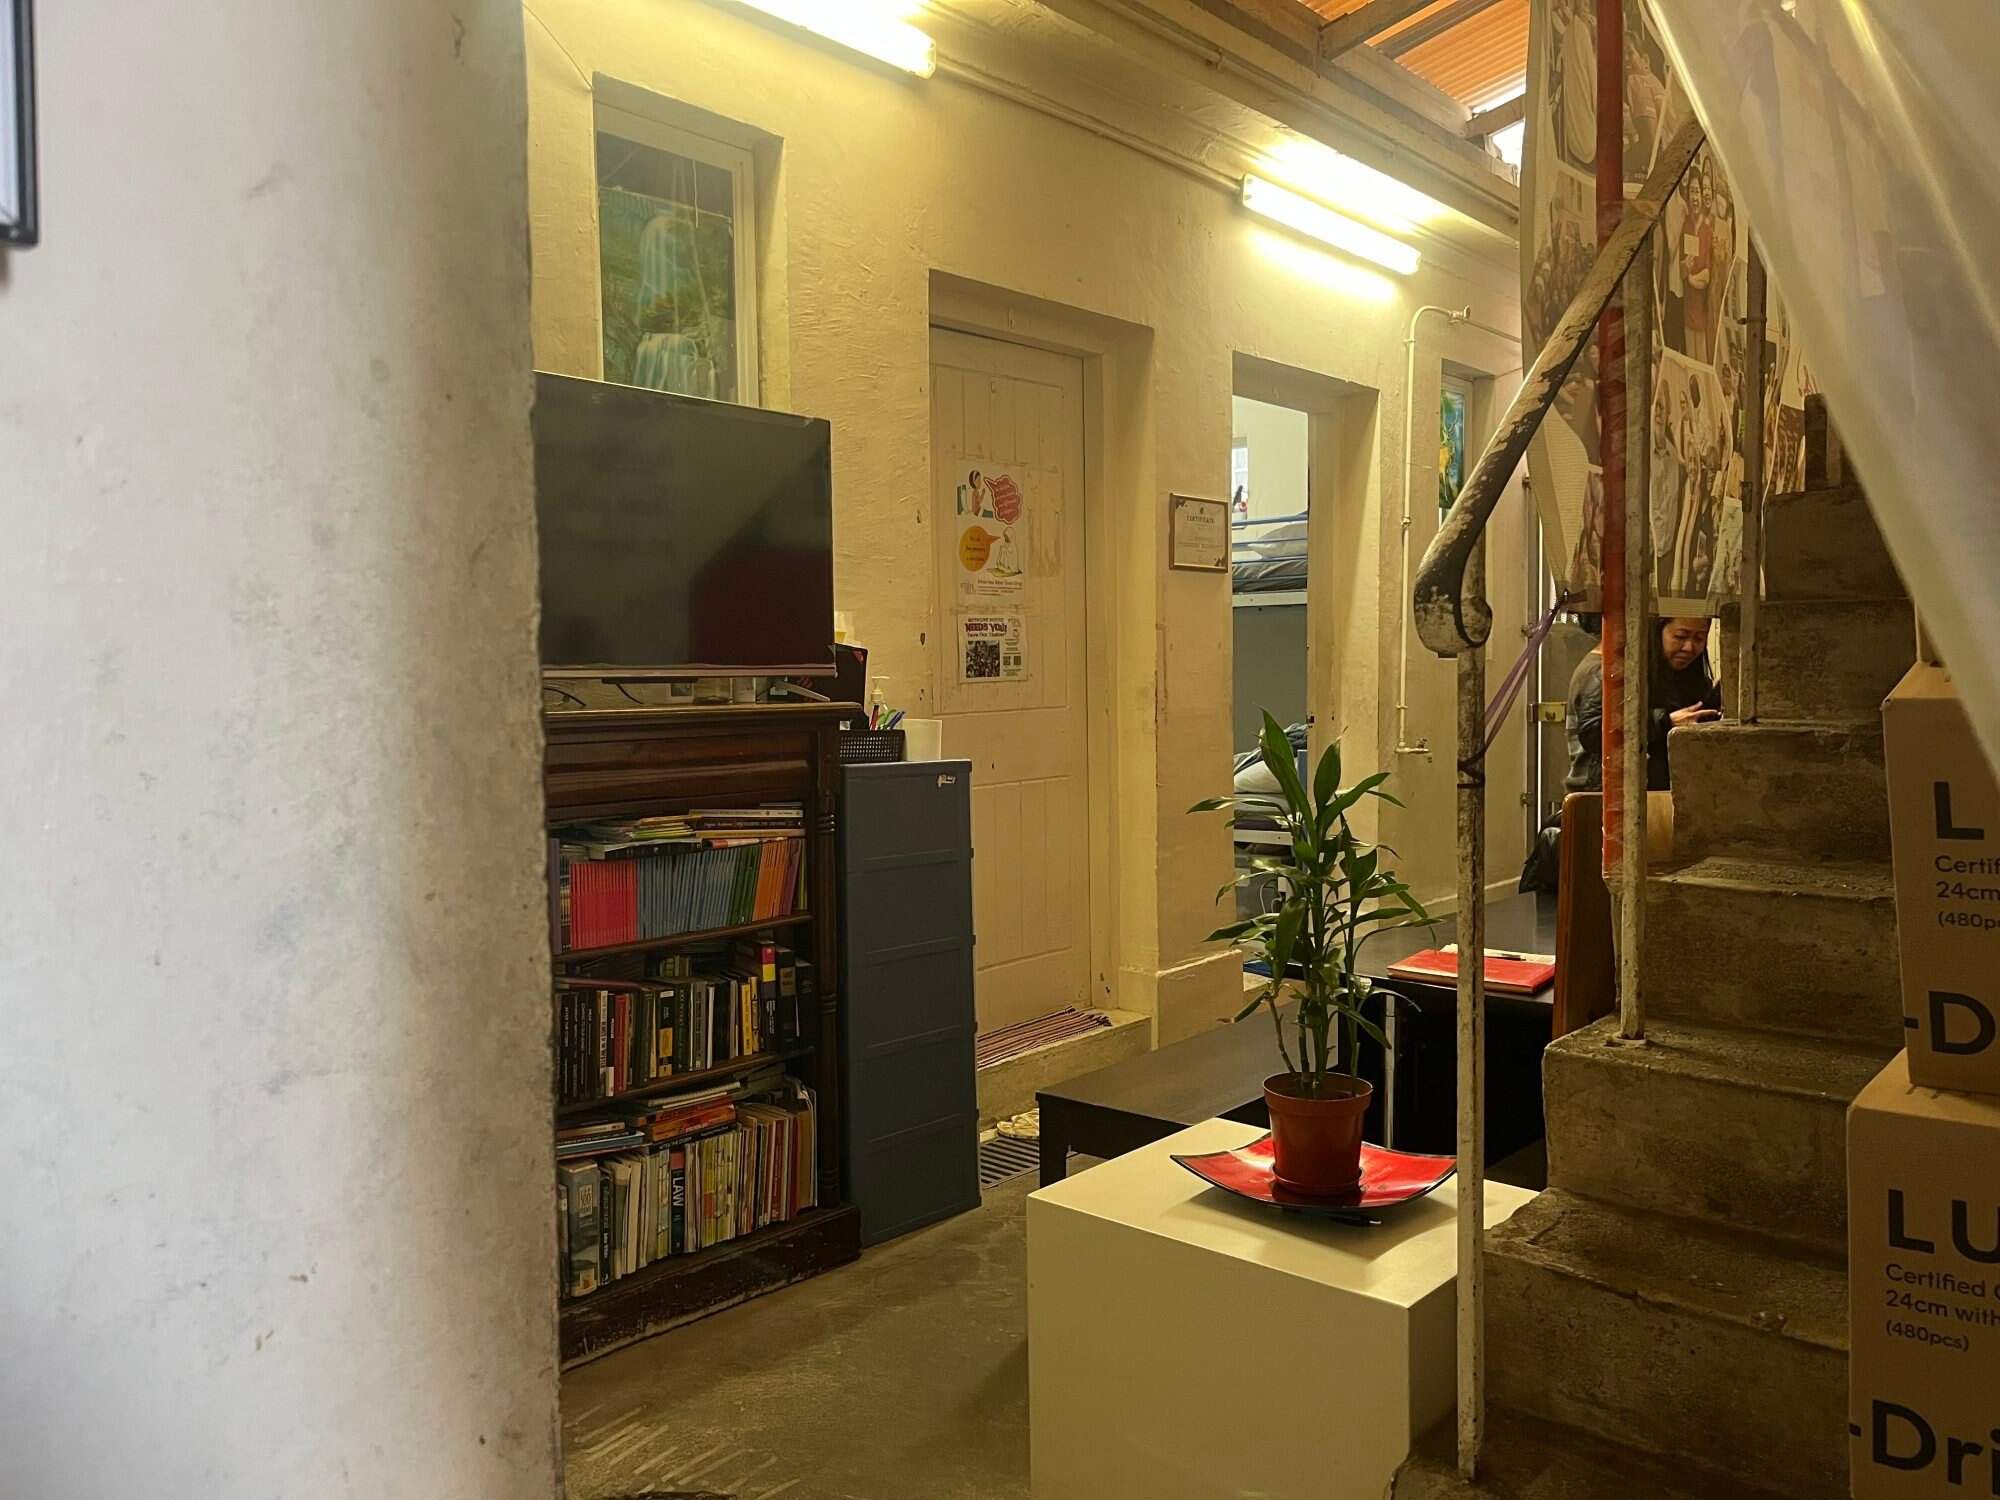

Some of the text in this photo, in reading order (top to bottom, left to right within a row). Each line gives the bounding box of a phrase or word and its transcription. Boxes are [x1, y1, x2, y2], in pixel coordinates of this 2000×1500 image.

[965, 623, 988, 632] NEEDS
[1936, 880, 2000, 901] 24cm
[672, 1176, 684, 1206] LAW
[1886, 1264, 1986, 1298] Certified
[1886, 1290, 2000, 1327] 24cm with
[1886, 1319, 1969, 1352] (480pcs)
